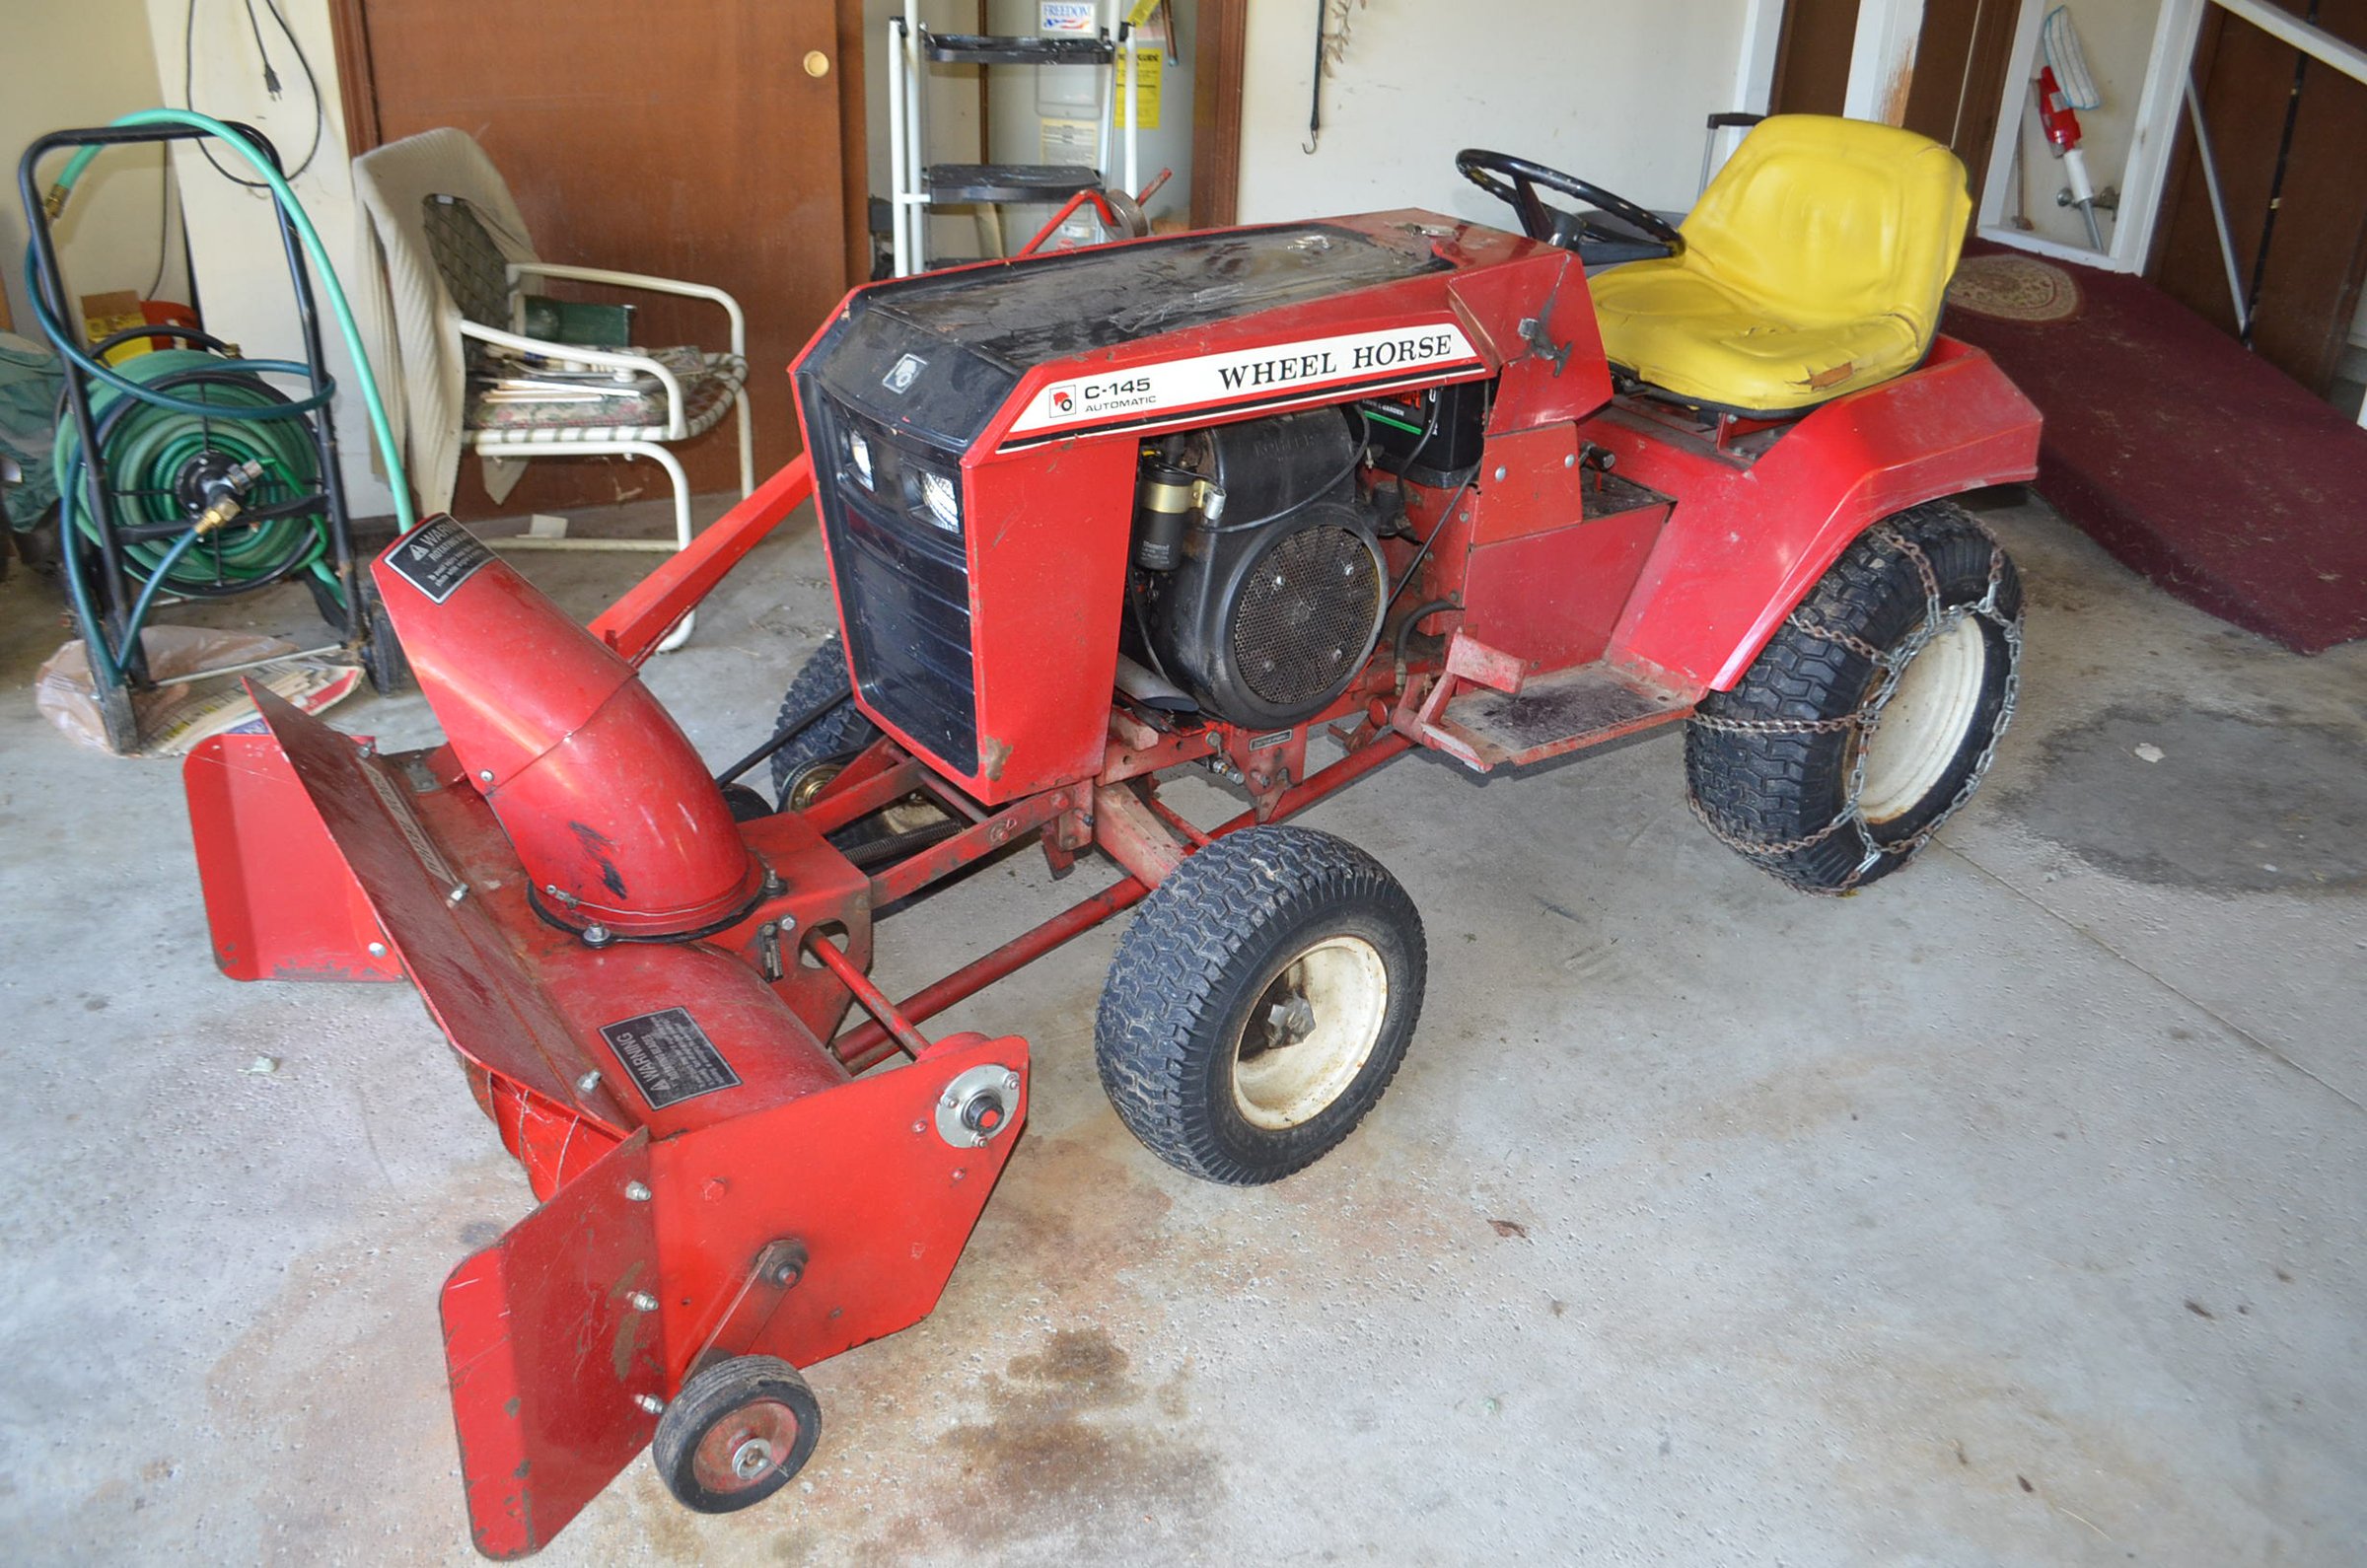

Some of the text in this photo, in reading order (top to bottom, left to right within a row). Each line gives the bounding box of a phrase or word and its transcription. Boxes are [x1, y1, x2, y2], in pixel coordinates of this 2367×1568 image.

[1042, 4, 1090, 17] FREEDOM
[1218, 334, 1452, 391] WHEEL HORSE
[1085, 378, 1151, 399] C-145
[1085, 395, 1157, 412] AUTOMATIC
[615, 1032, 660, 1083] WARNING
